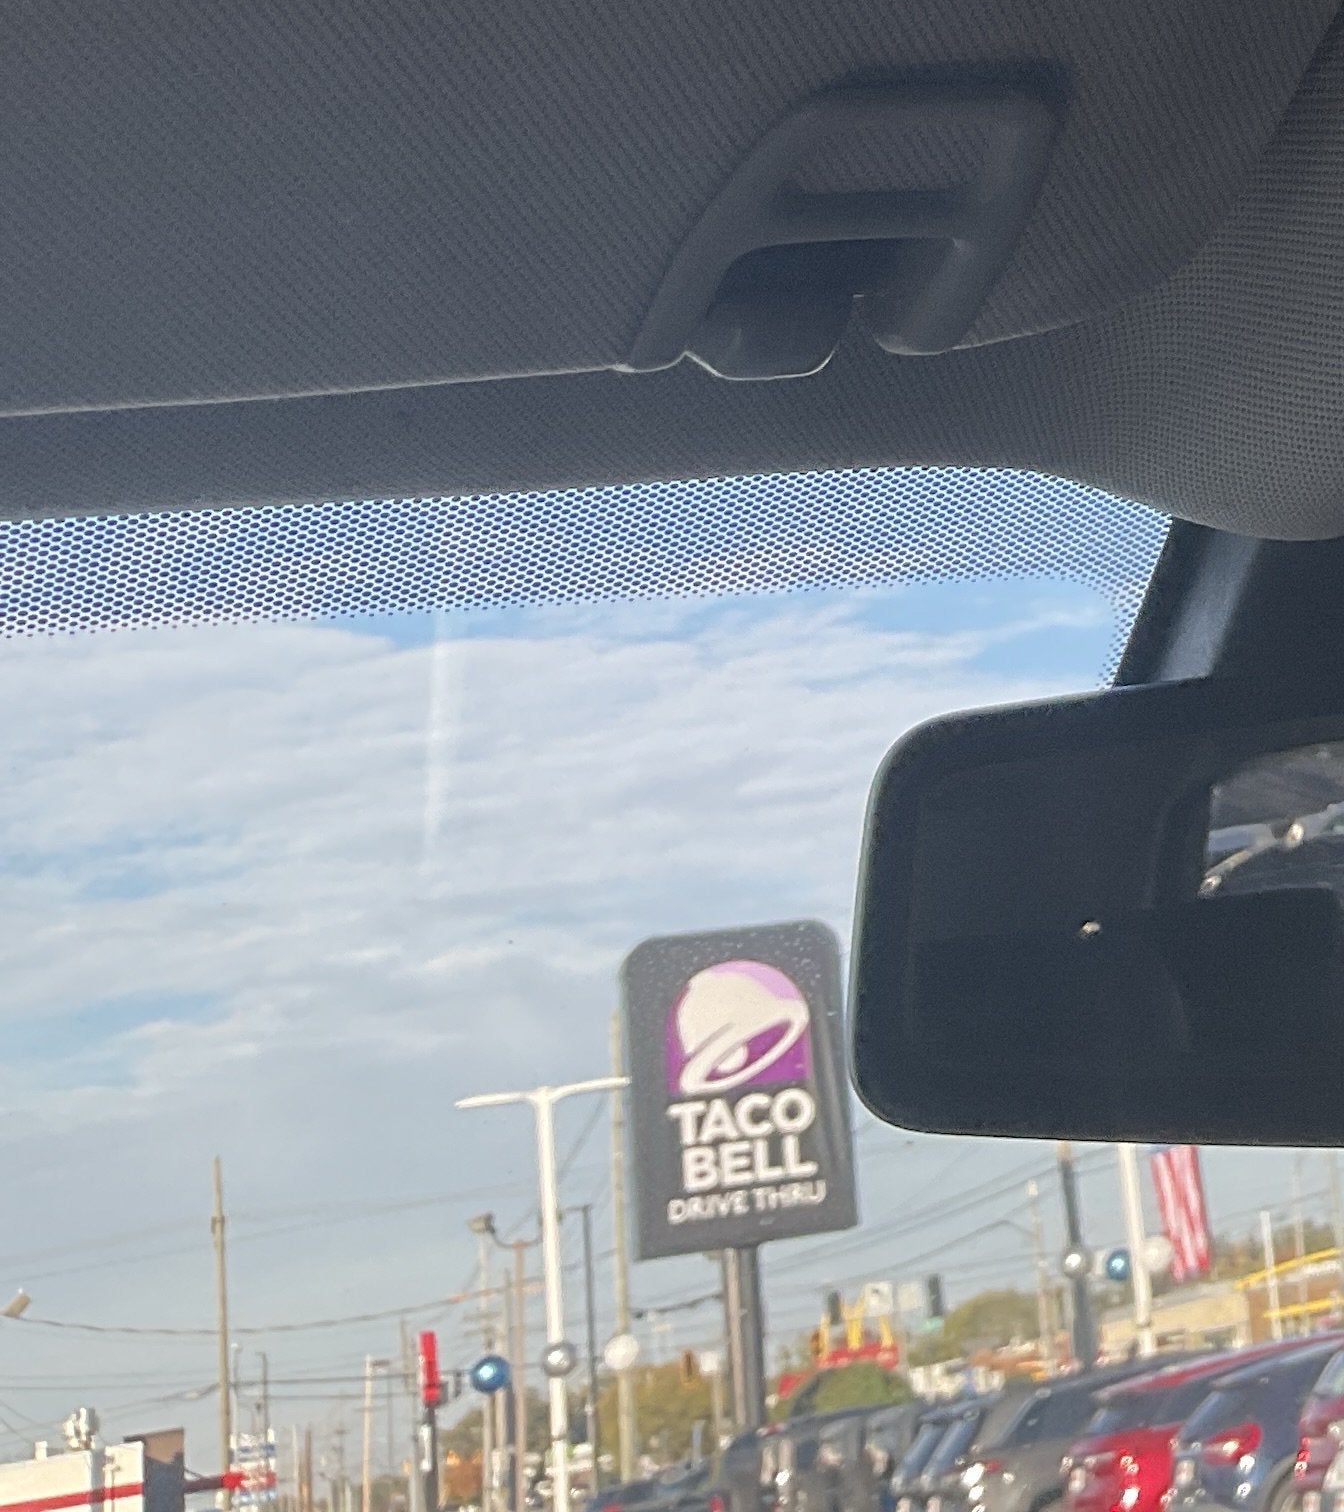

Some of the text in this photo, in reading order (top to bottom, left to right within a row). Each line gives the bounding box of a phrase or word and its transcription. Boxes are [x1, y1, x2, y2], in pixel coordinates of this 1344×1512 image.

[666, 1088, 816, 1144] TACO
[682, 1136, 818, 1192] BELL
[667, 1180, 827, 1225] DRIVE THRU
